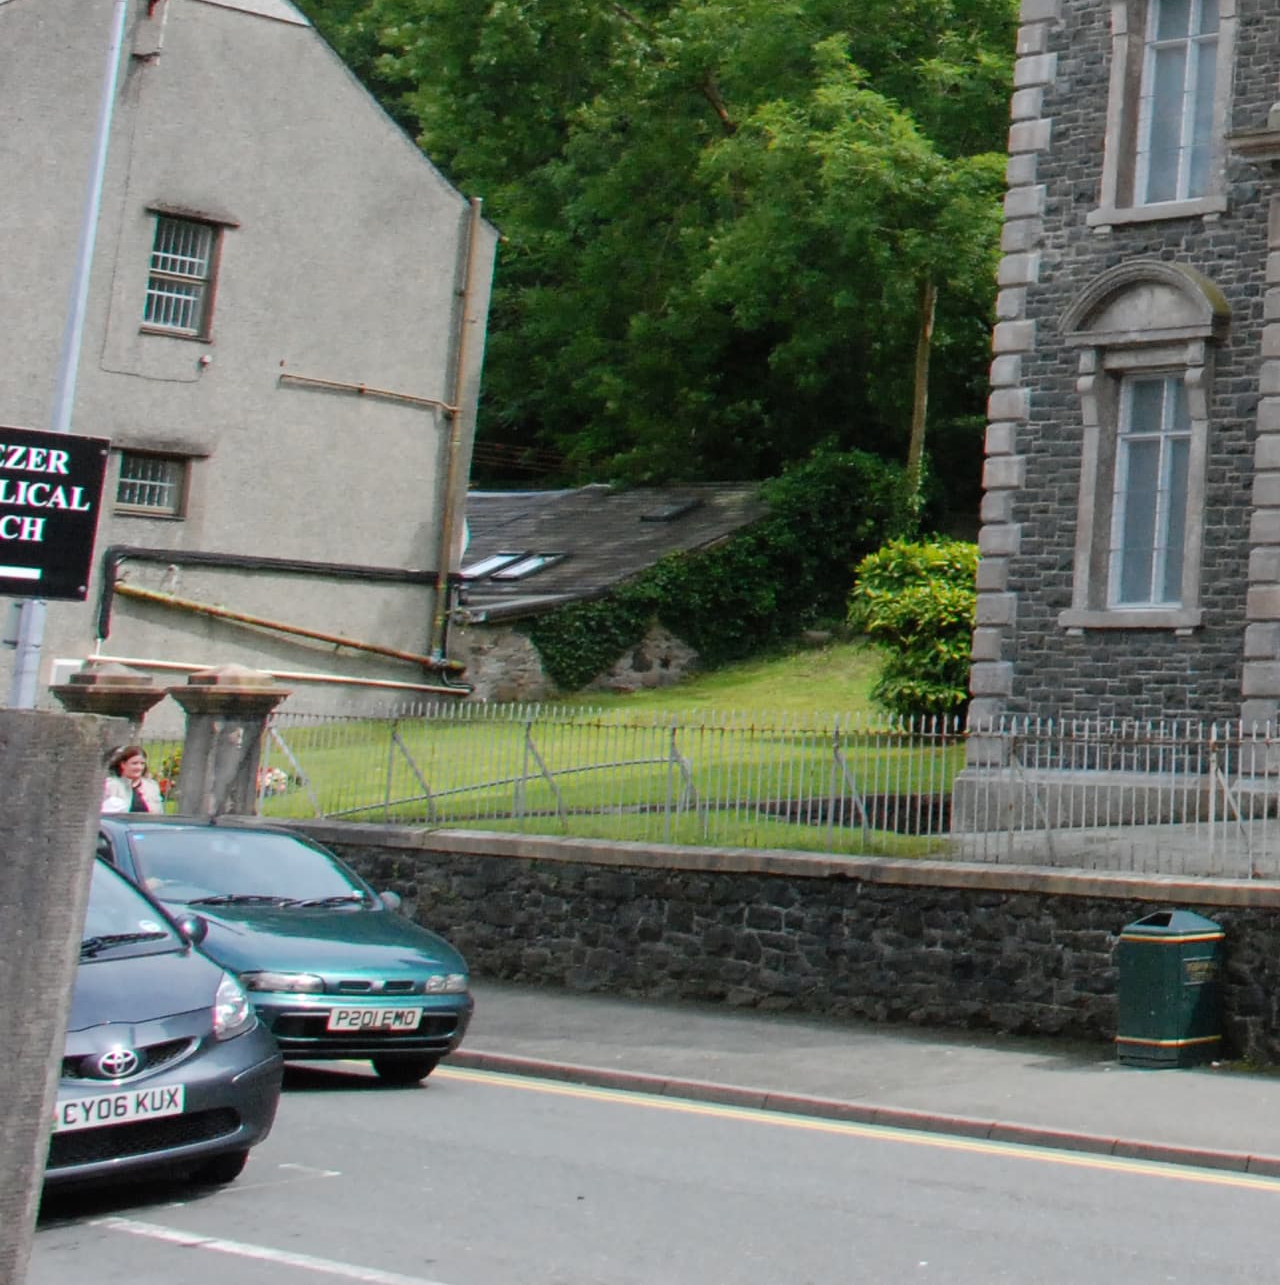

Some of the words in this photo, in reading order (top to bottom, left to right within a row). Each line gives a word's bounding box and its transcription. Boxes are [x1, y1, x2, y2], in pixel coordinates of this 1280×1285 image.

[0, 444, 70, 475] ZER
[0, 479, 91, 511] LICAL
[63, 1096, 127, 1124] CY06
[135, 1087, 180, 1114] KUX
